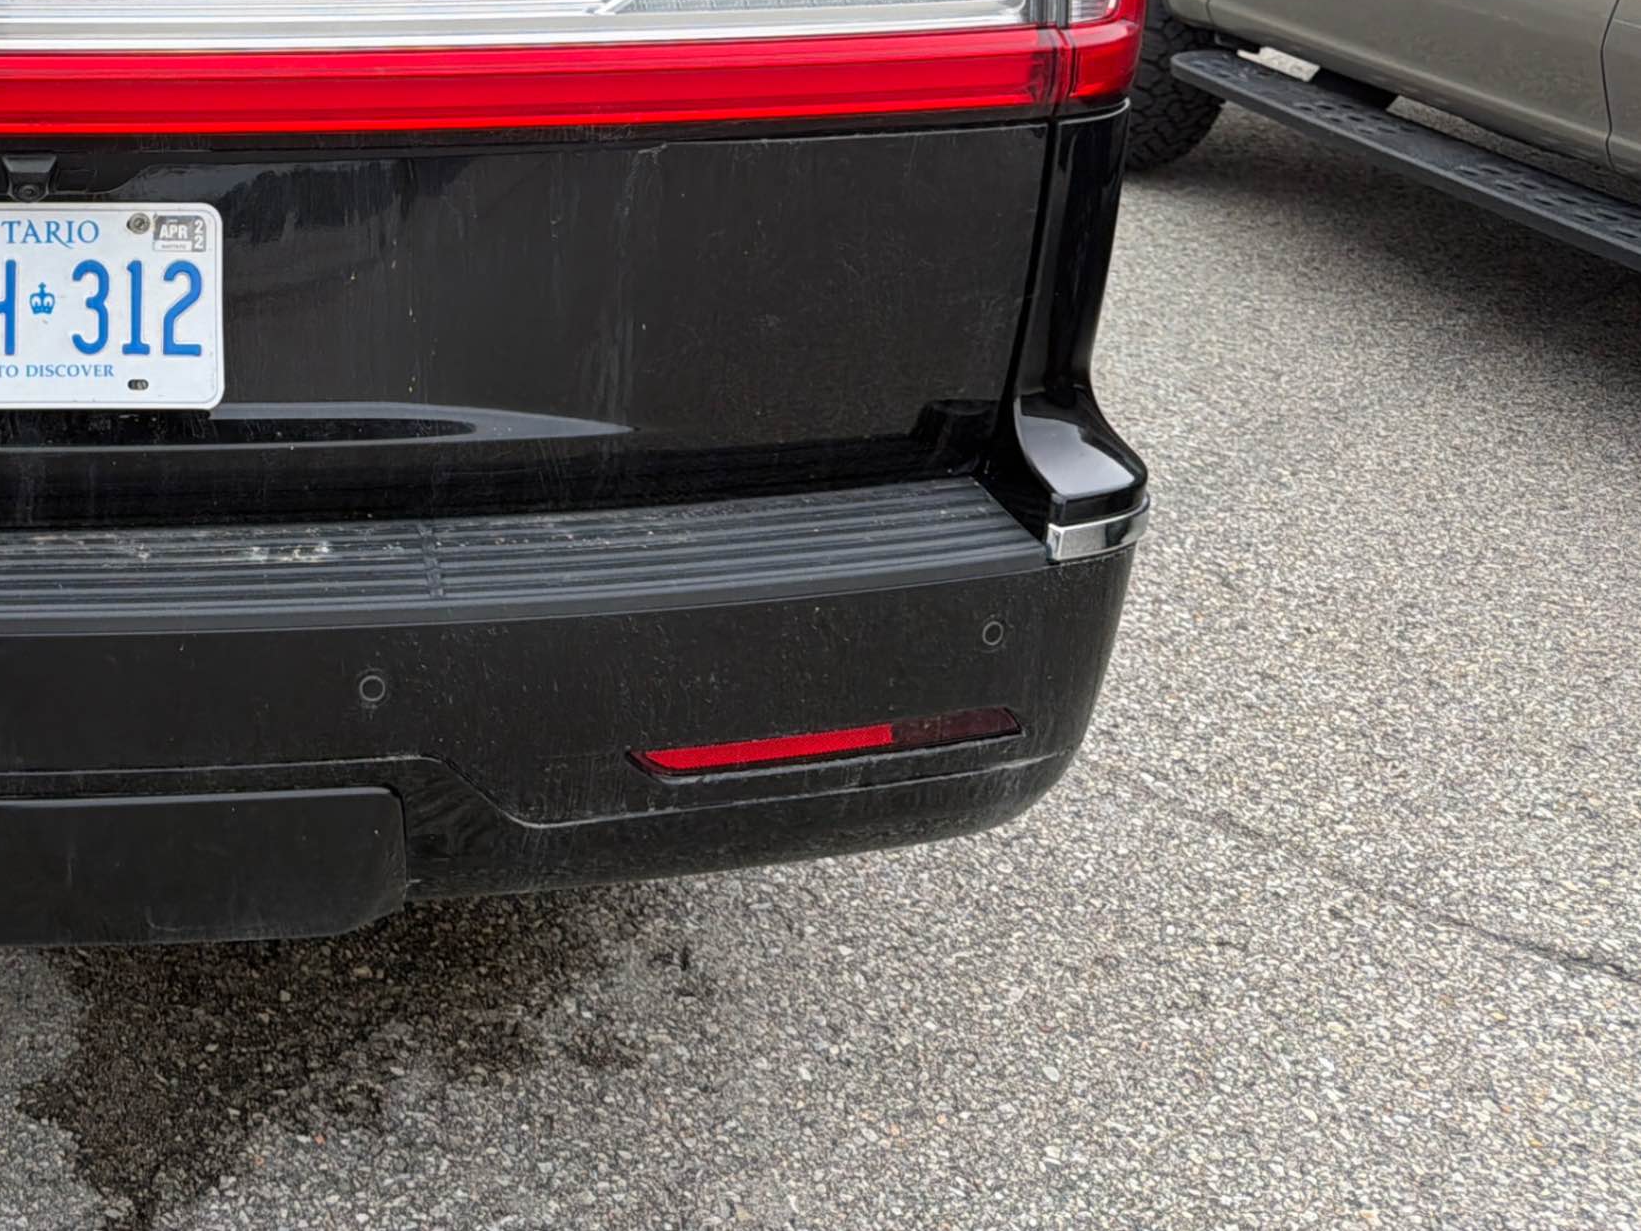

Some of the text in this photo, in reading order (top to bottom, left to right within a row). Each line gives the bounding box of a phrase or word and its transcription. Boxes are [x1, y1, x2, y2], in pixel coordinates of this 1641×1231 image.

[159, 224, 188, 239] APR
[70, 259, 204, 357] 312
[25, 363, 115, 378] DISCOVER
